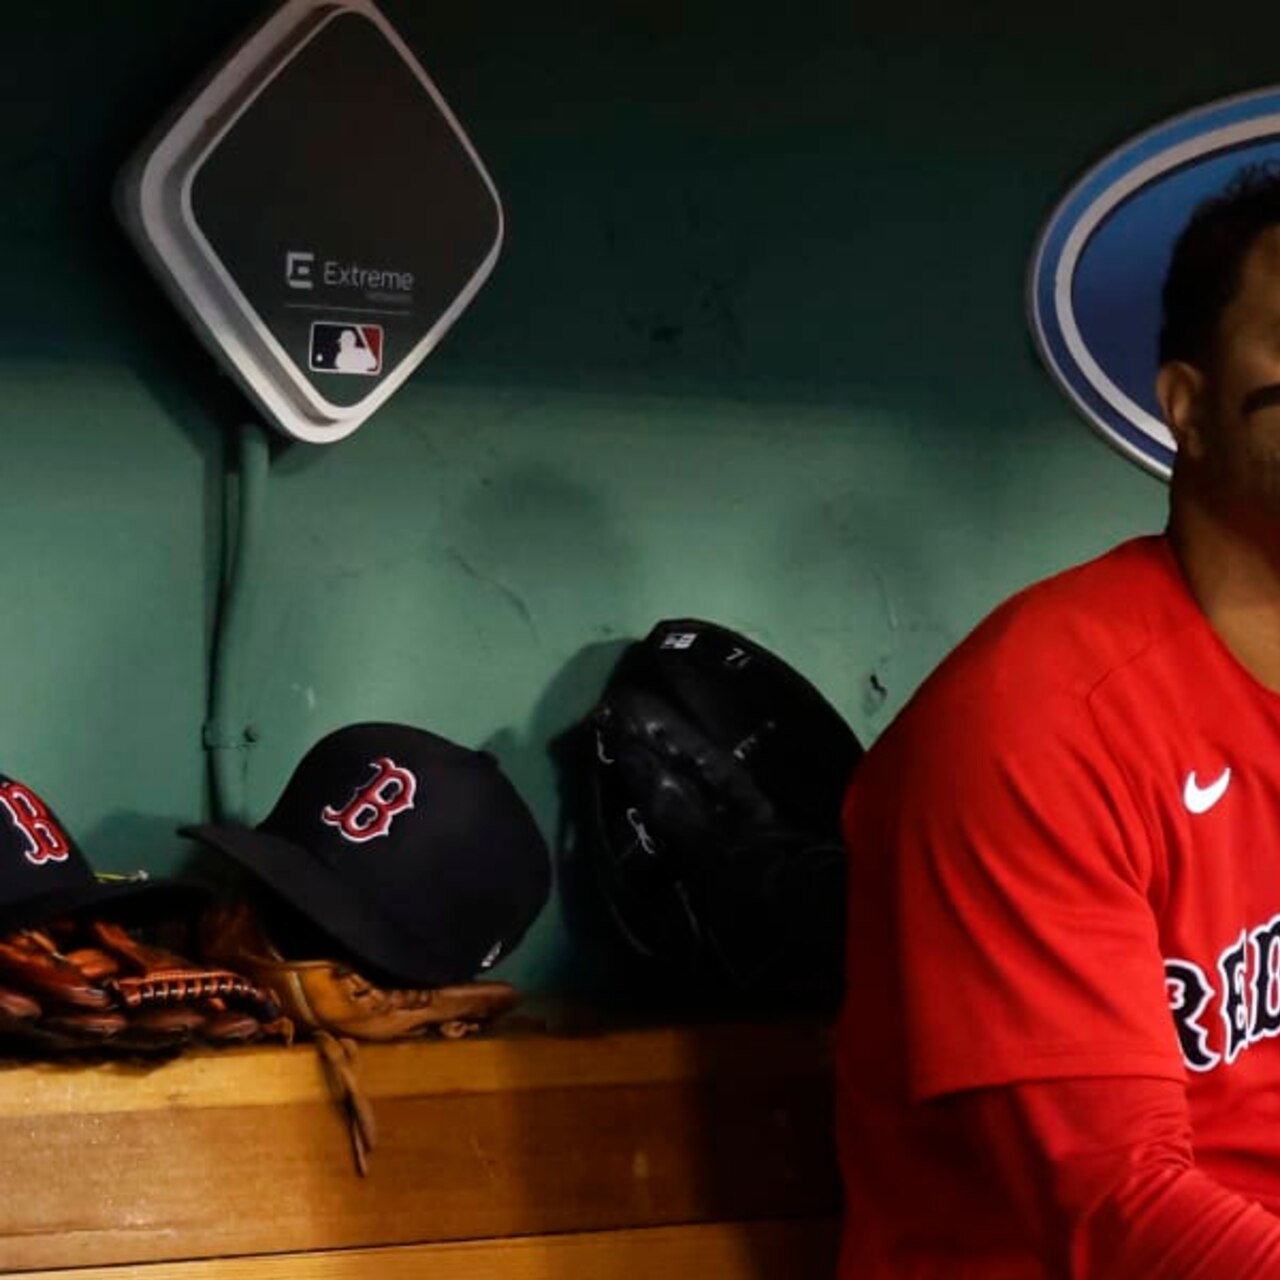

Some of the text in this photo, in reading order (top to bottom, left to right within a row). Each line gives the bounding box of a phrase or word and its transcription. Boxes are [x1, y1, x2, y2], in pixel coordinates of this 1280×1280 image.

[323, 261, 415, 291] Extreme
[0, 783, 69, 864] B
[321, 757, 417, 843] B
